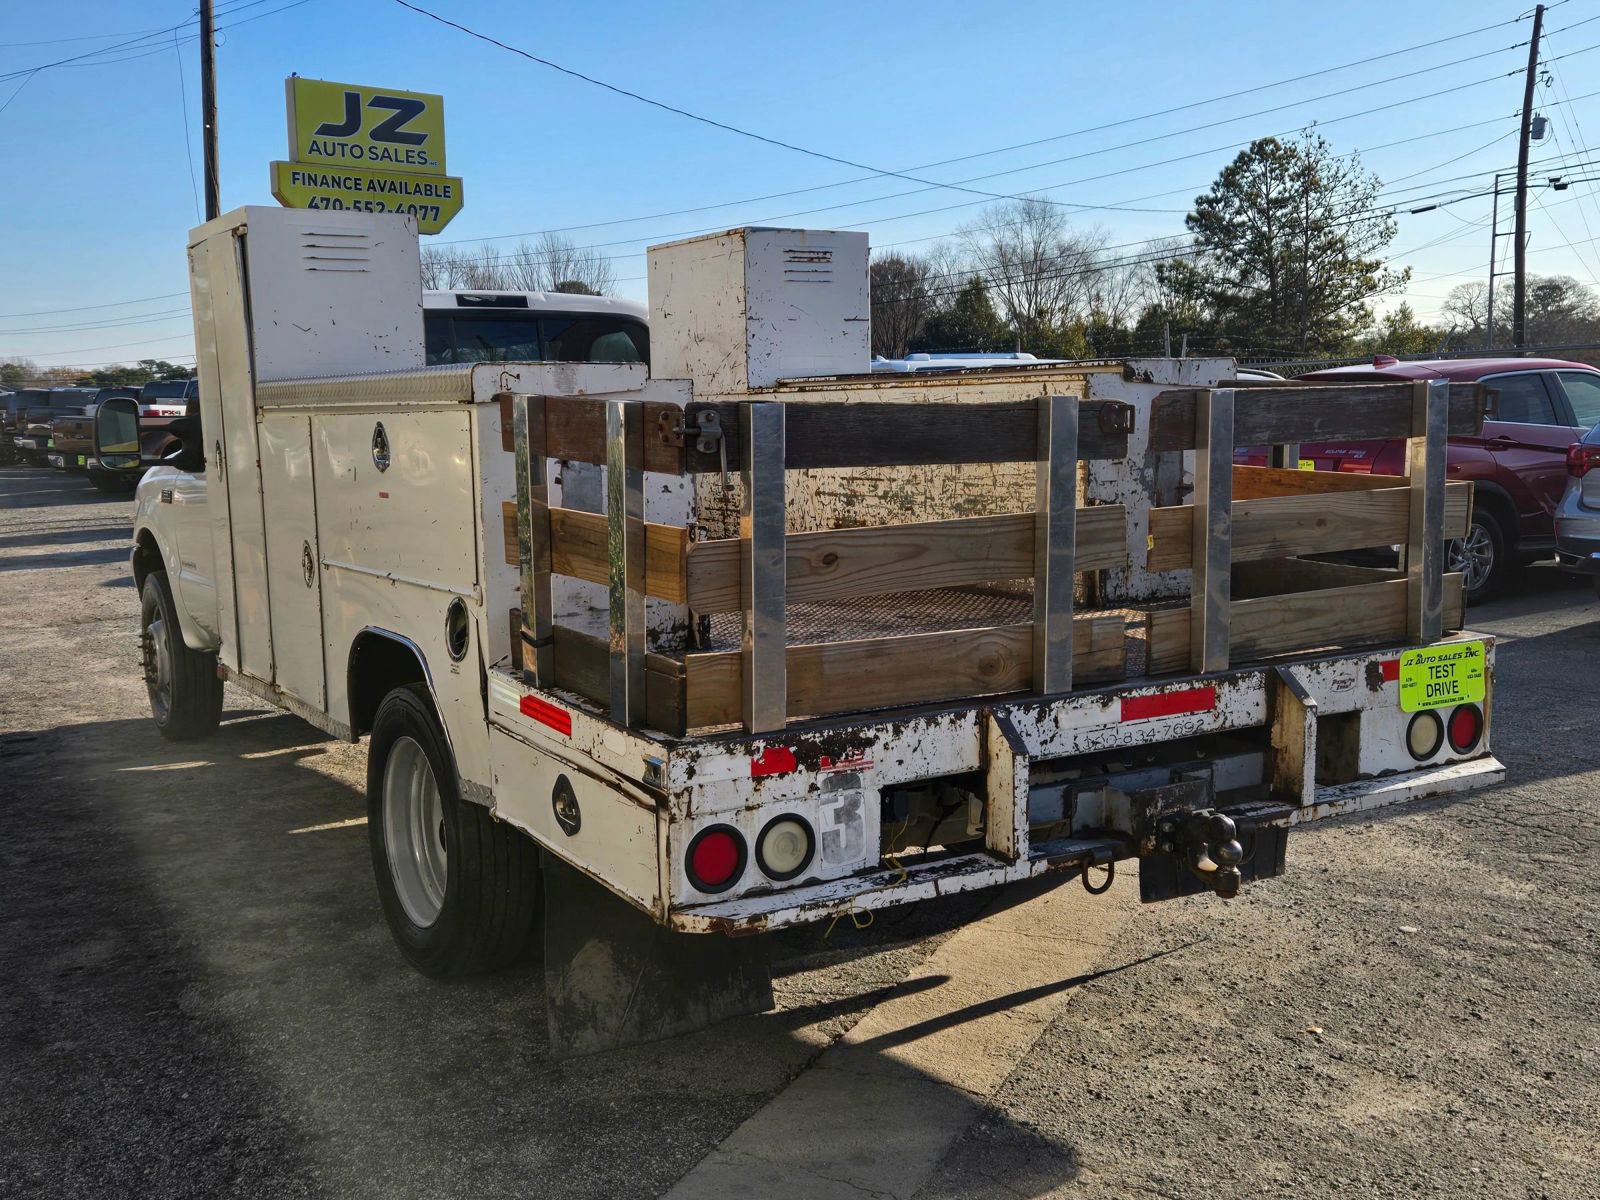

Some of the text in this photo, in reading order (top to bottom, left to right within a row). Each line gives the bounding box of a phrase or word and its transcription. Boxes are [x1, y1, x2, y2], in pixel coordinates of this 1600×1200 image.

[314, 91, 429, 146] JZ
[307, 140, 365, 160] AUTO
[368, 145, 428, 166] SALES
[291, 171, 452, 198] FINANCE AVAILABLE
[1415, 655, 1436, 665] AUTO
[1438, 652, 1463, 662] SALES
[1464, 649, 1480, 658] INC
[1428, 663, 1456, 680] TEST
[1426, 680, 1459, 698] DRIVE
